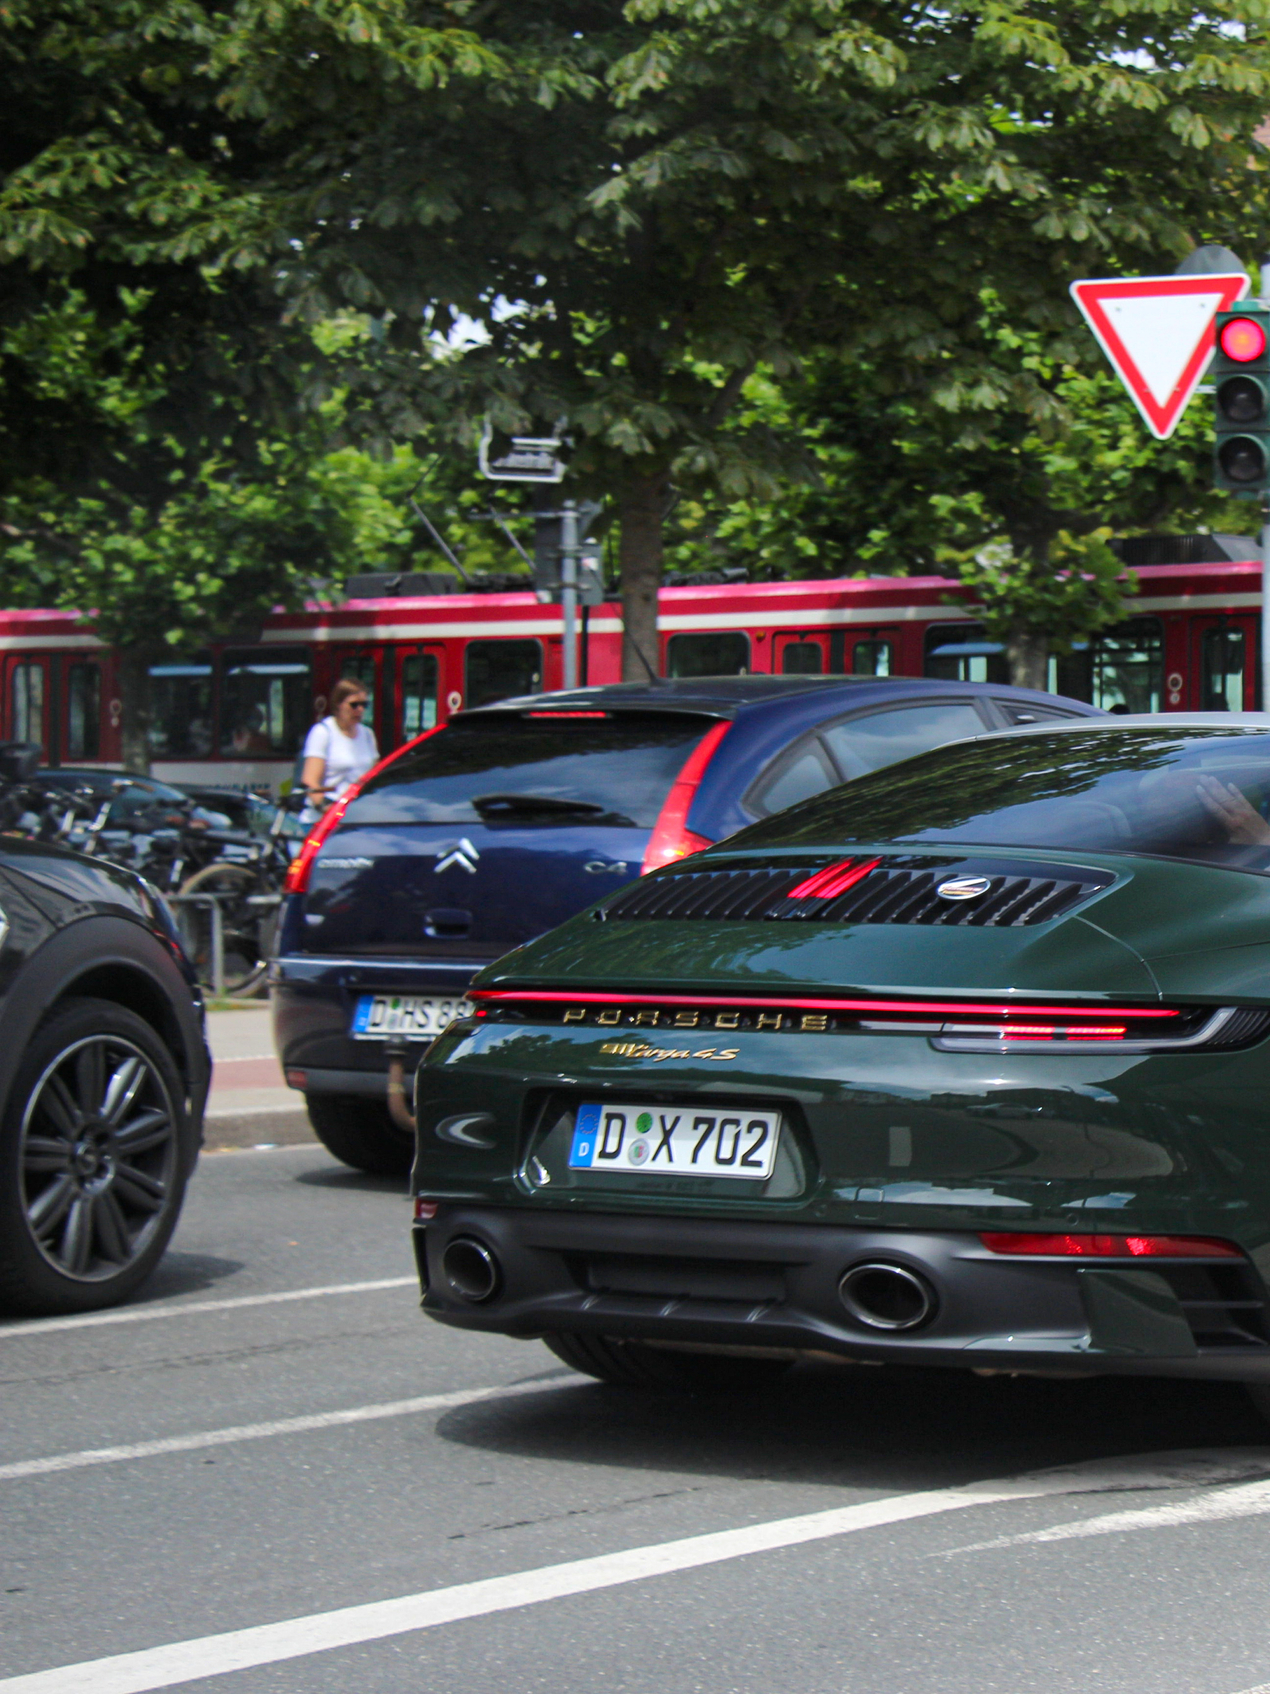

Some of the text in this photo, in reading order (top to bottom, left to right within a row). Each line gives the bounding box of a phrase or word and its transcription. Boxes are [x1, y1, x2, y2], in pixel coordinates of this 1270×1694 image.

[562, 1008, 828, 1030] PORSCHE
[598, 1112, 770, 1168] D X 702
